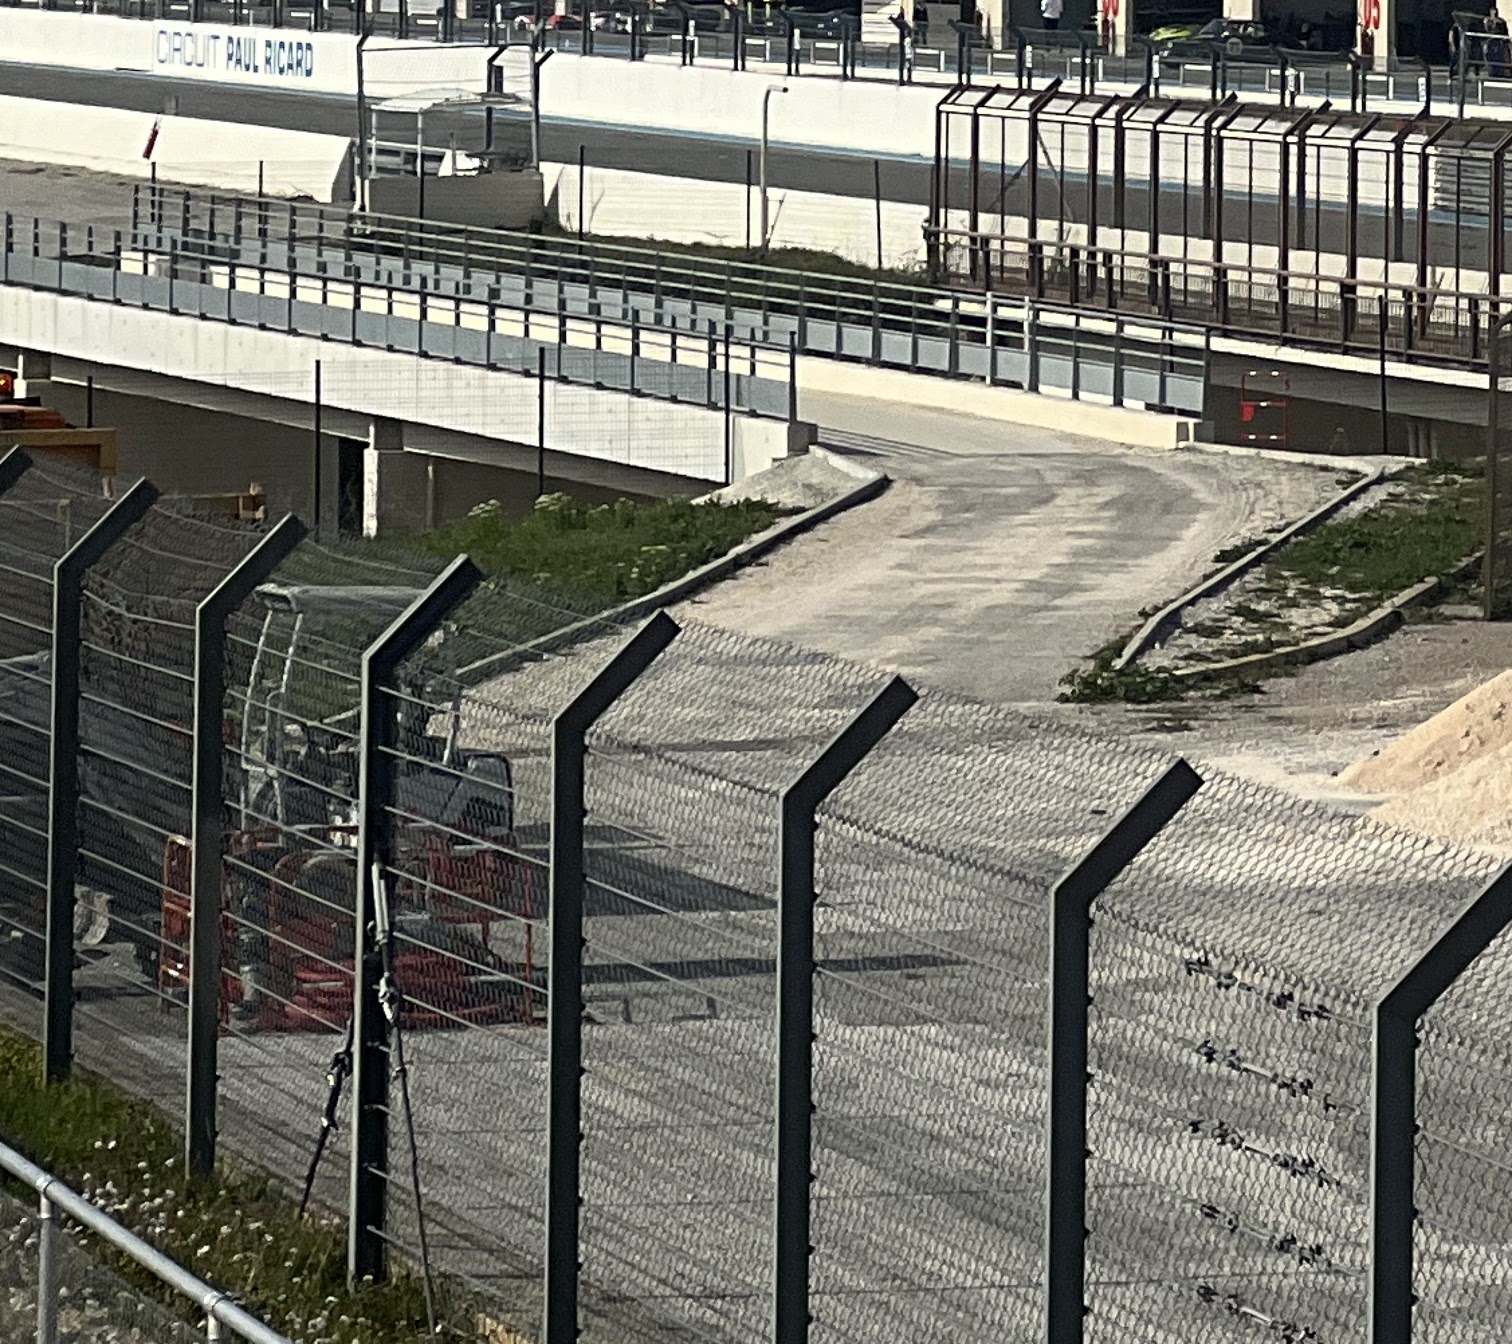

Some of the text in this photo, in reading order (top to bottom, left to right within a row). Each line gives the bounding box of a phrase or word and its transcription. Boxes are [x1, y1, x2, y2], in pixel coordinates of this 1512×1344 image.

[157, 30, 313, 77] CIRCUIT PAUL RICARD
